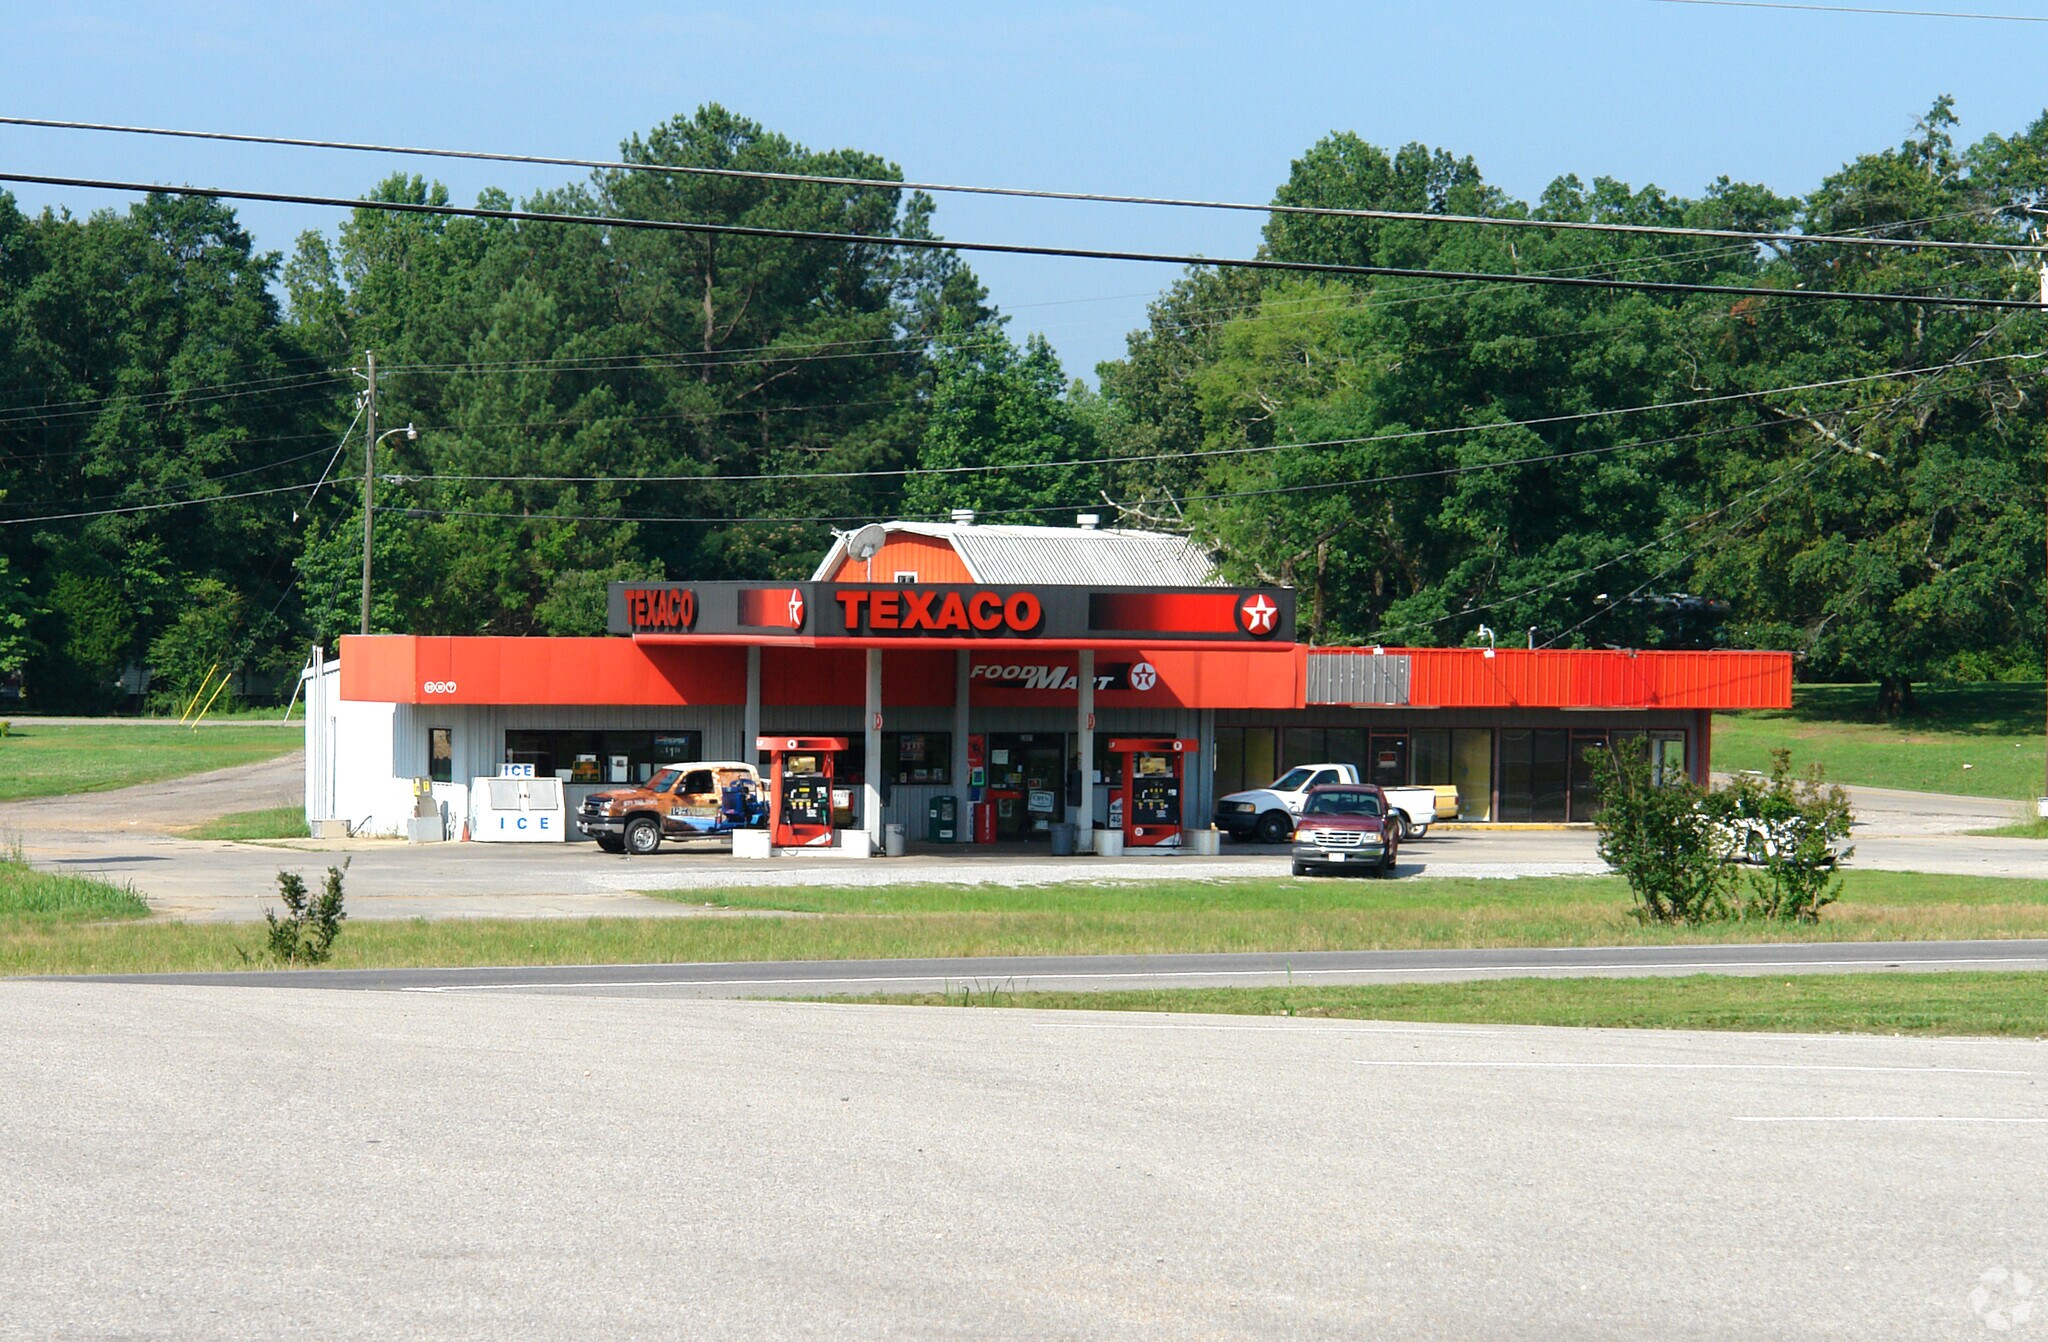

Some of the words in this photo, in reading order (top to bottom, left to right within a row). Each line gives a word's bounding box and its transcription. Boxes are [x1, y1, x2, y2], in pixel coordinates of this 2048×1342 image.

[624, 587, 694, 627] TEXACO
[836, 590, 1042, 631] TEXACO
[970, 664, 1037, 679] FOOD
[1024, 666, 1115, 690] MAT
[504, 765, 532, 776] ICE
[500, 817, 549, 830] ICE
